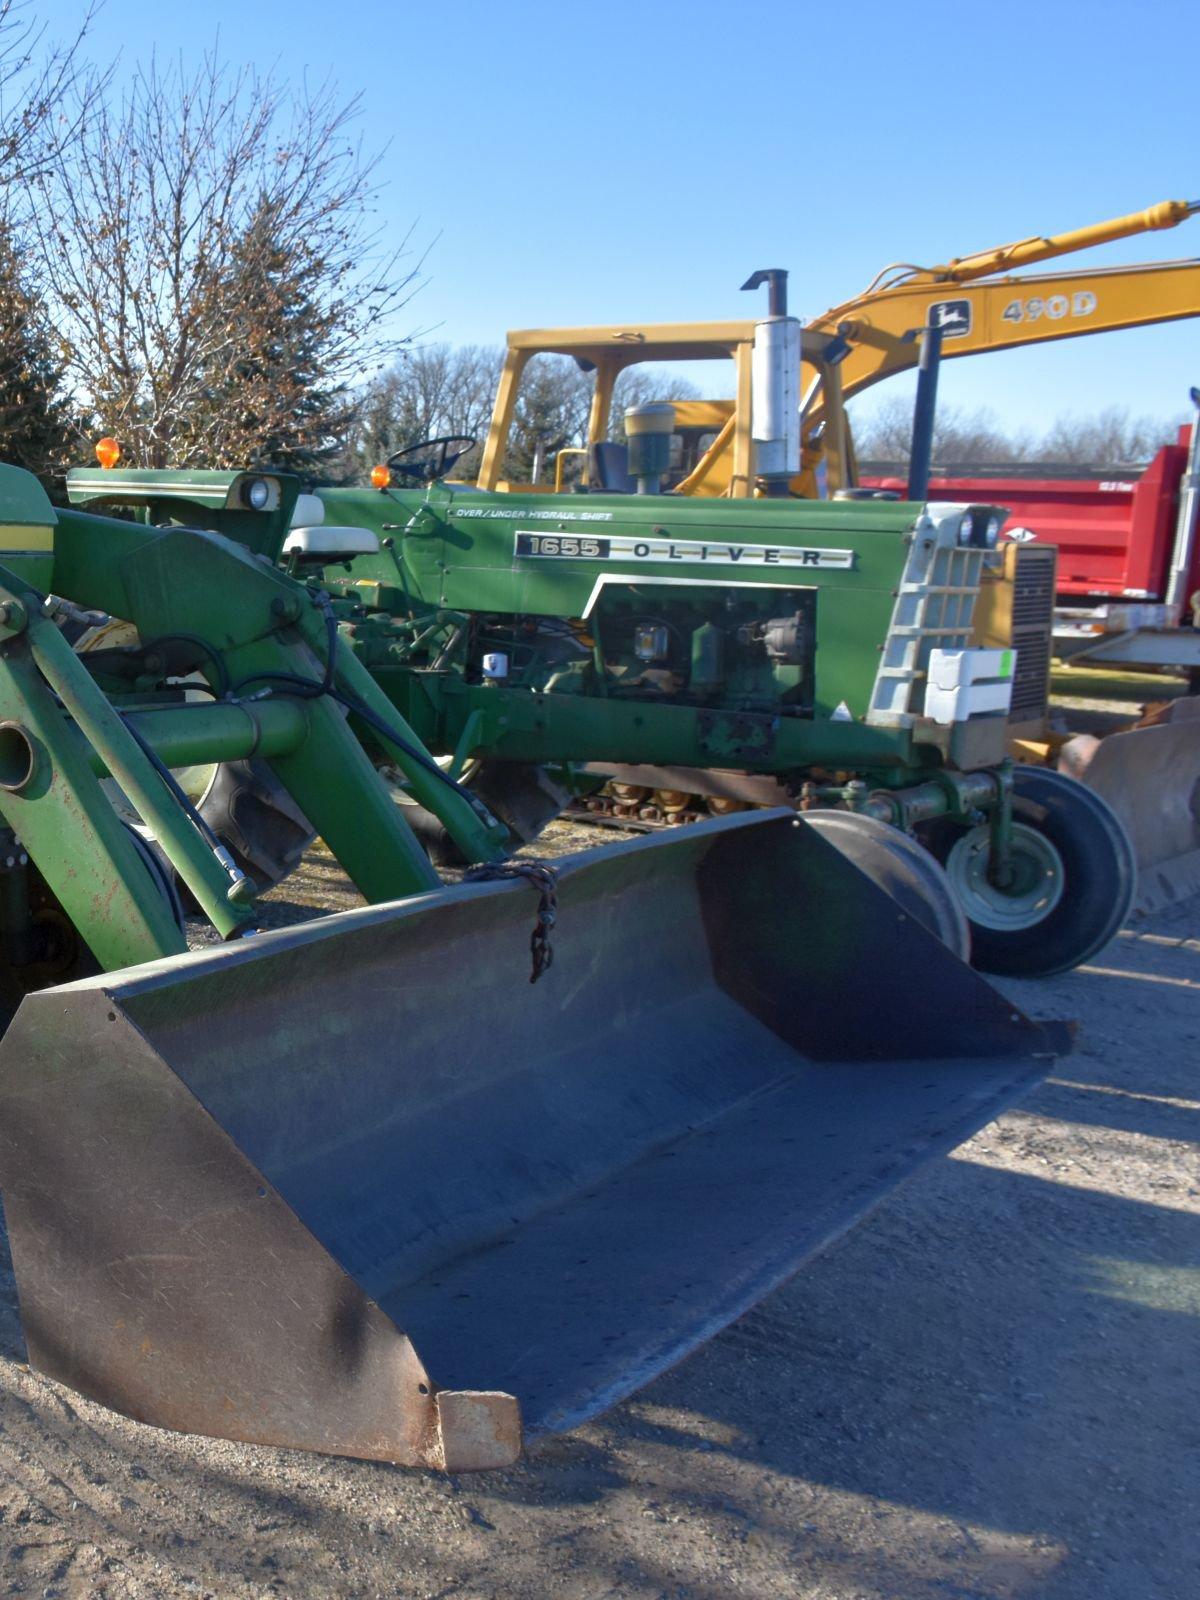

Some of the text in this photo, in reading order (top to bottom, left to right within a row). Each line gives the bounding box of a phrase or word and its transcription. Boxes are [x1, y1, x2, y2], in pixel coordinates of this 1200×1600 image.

[1000, 290, 1098, 324] 490D
[528, 510, 577, 520] HYDRAUL
[580, 511, 614, 521] SHIFT
[529, 536, 822, 565] 1655 OLIVER
